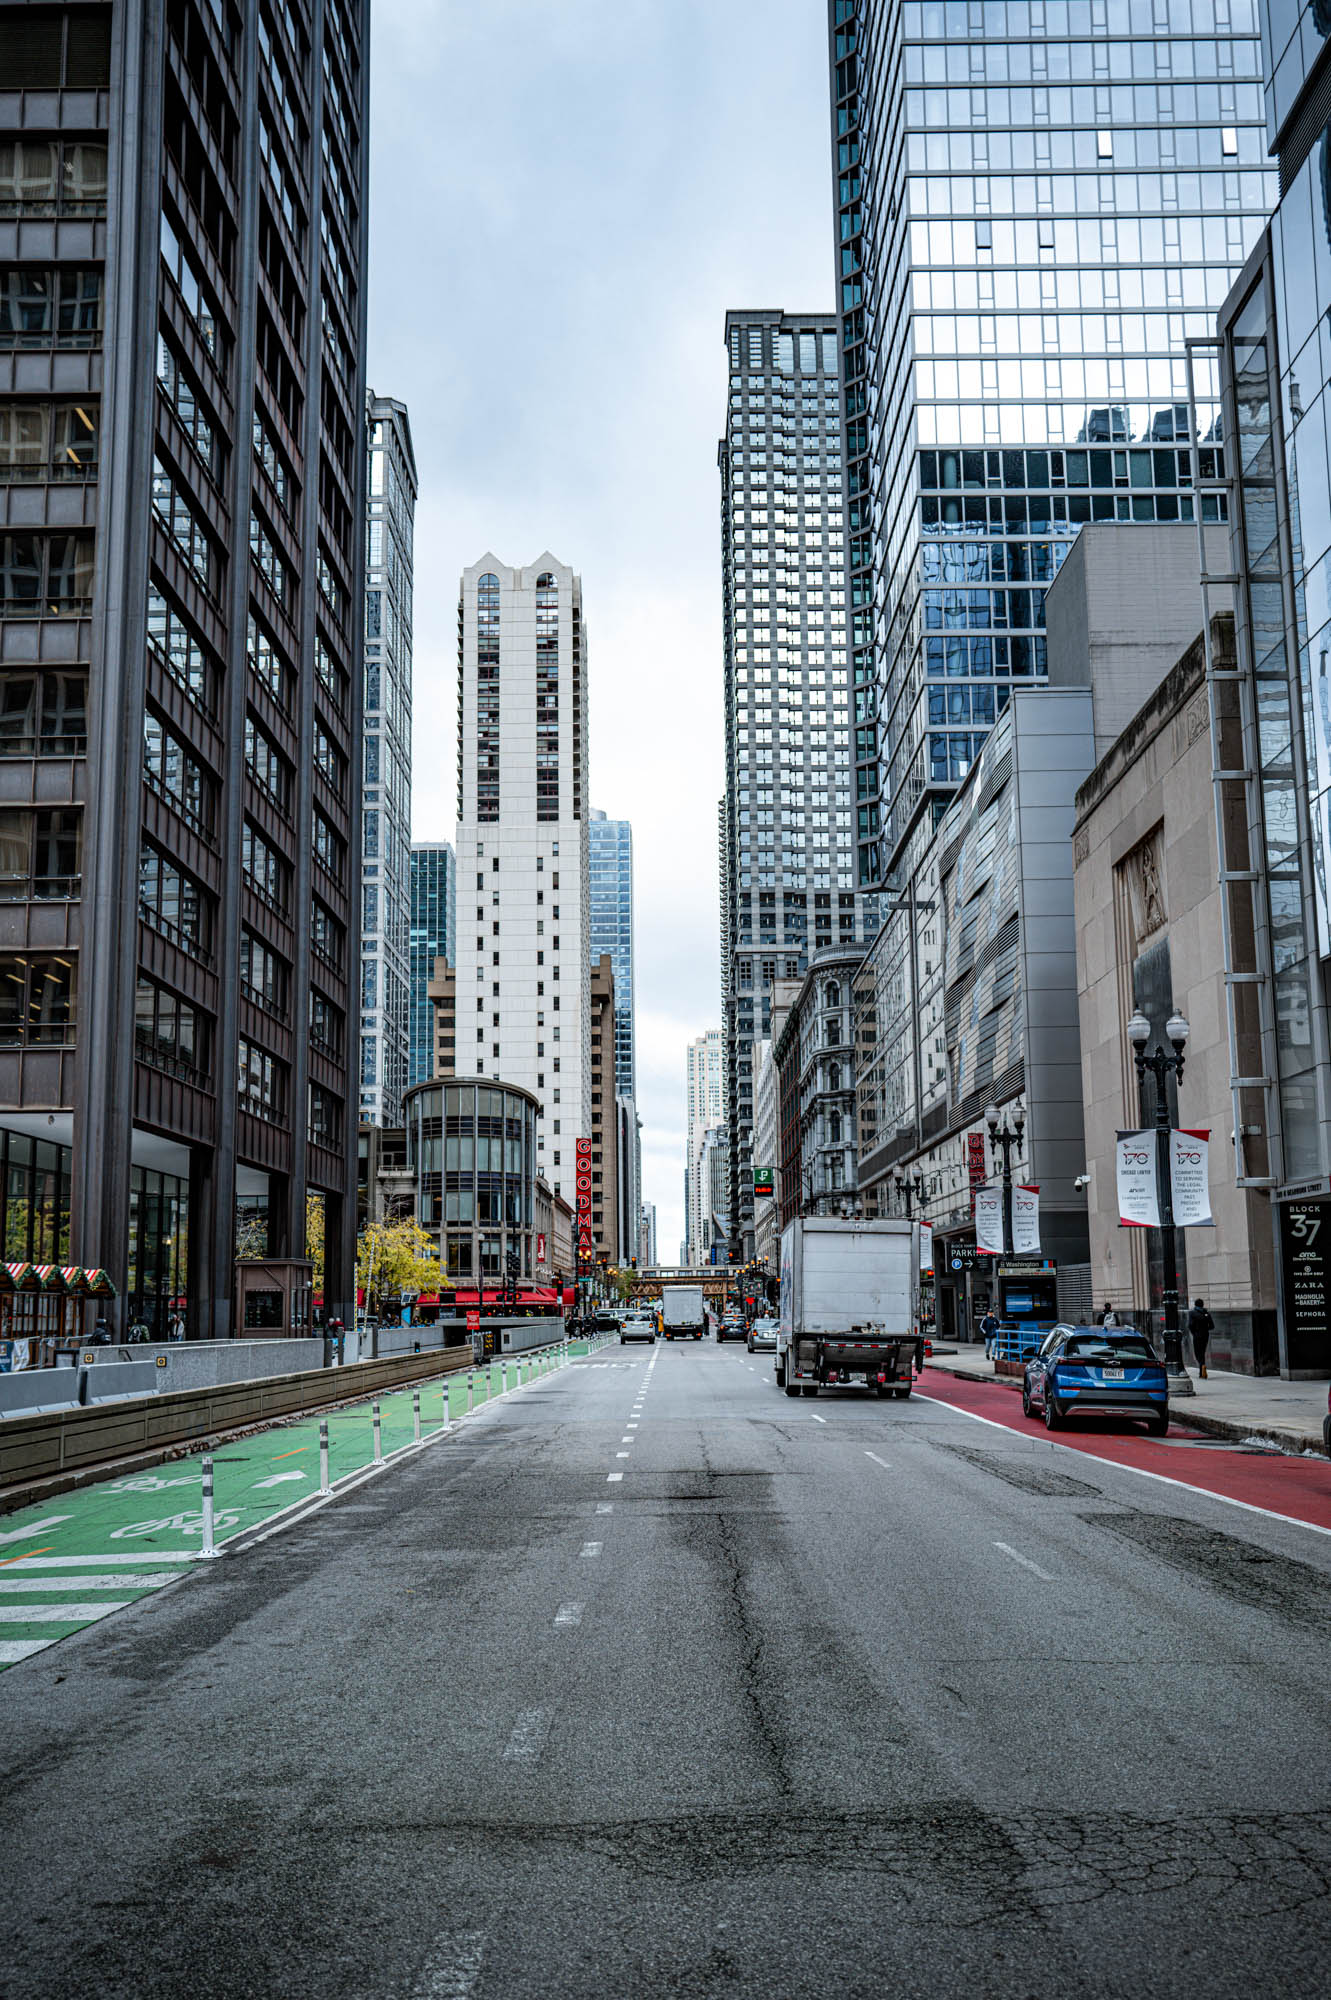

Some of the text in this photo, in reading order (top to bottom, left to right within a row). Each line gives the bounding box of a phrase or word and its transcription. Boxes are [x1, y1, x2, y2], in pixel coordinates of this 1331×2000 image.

[1123, 1152, 1149, 1165] 170
[1175, 1152, 1201, 1165] 170
[577, 1139, 591, 1263] GOODMA
[1290, 1214, 1321, 1246] 37
